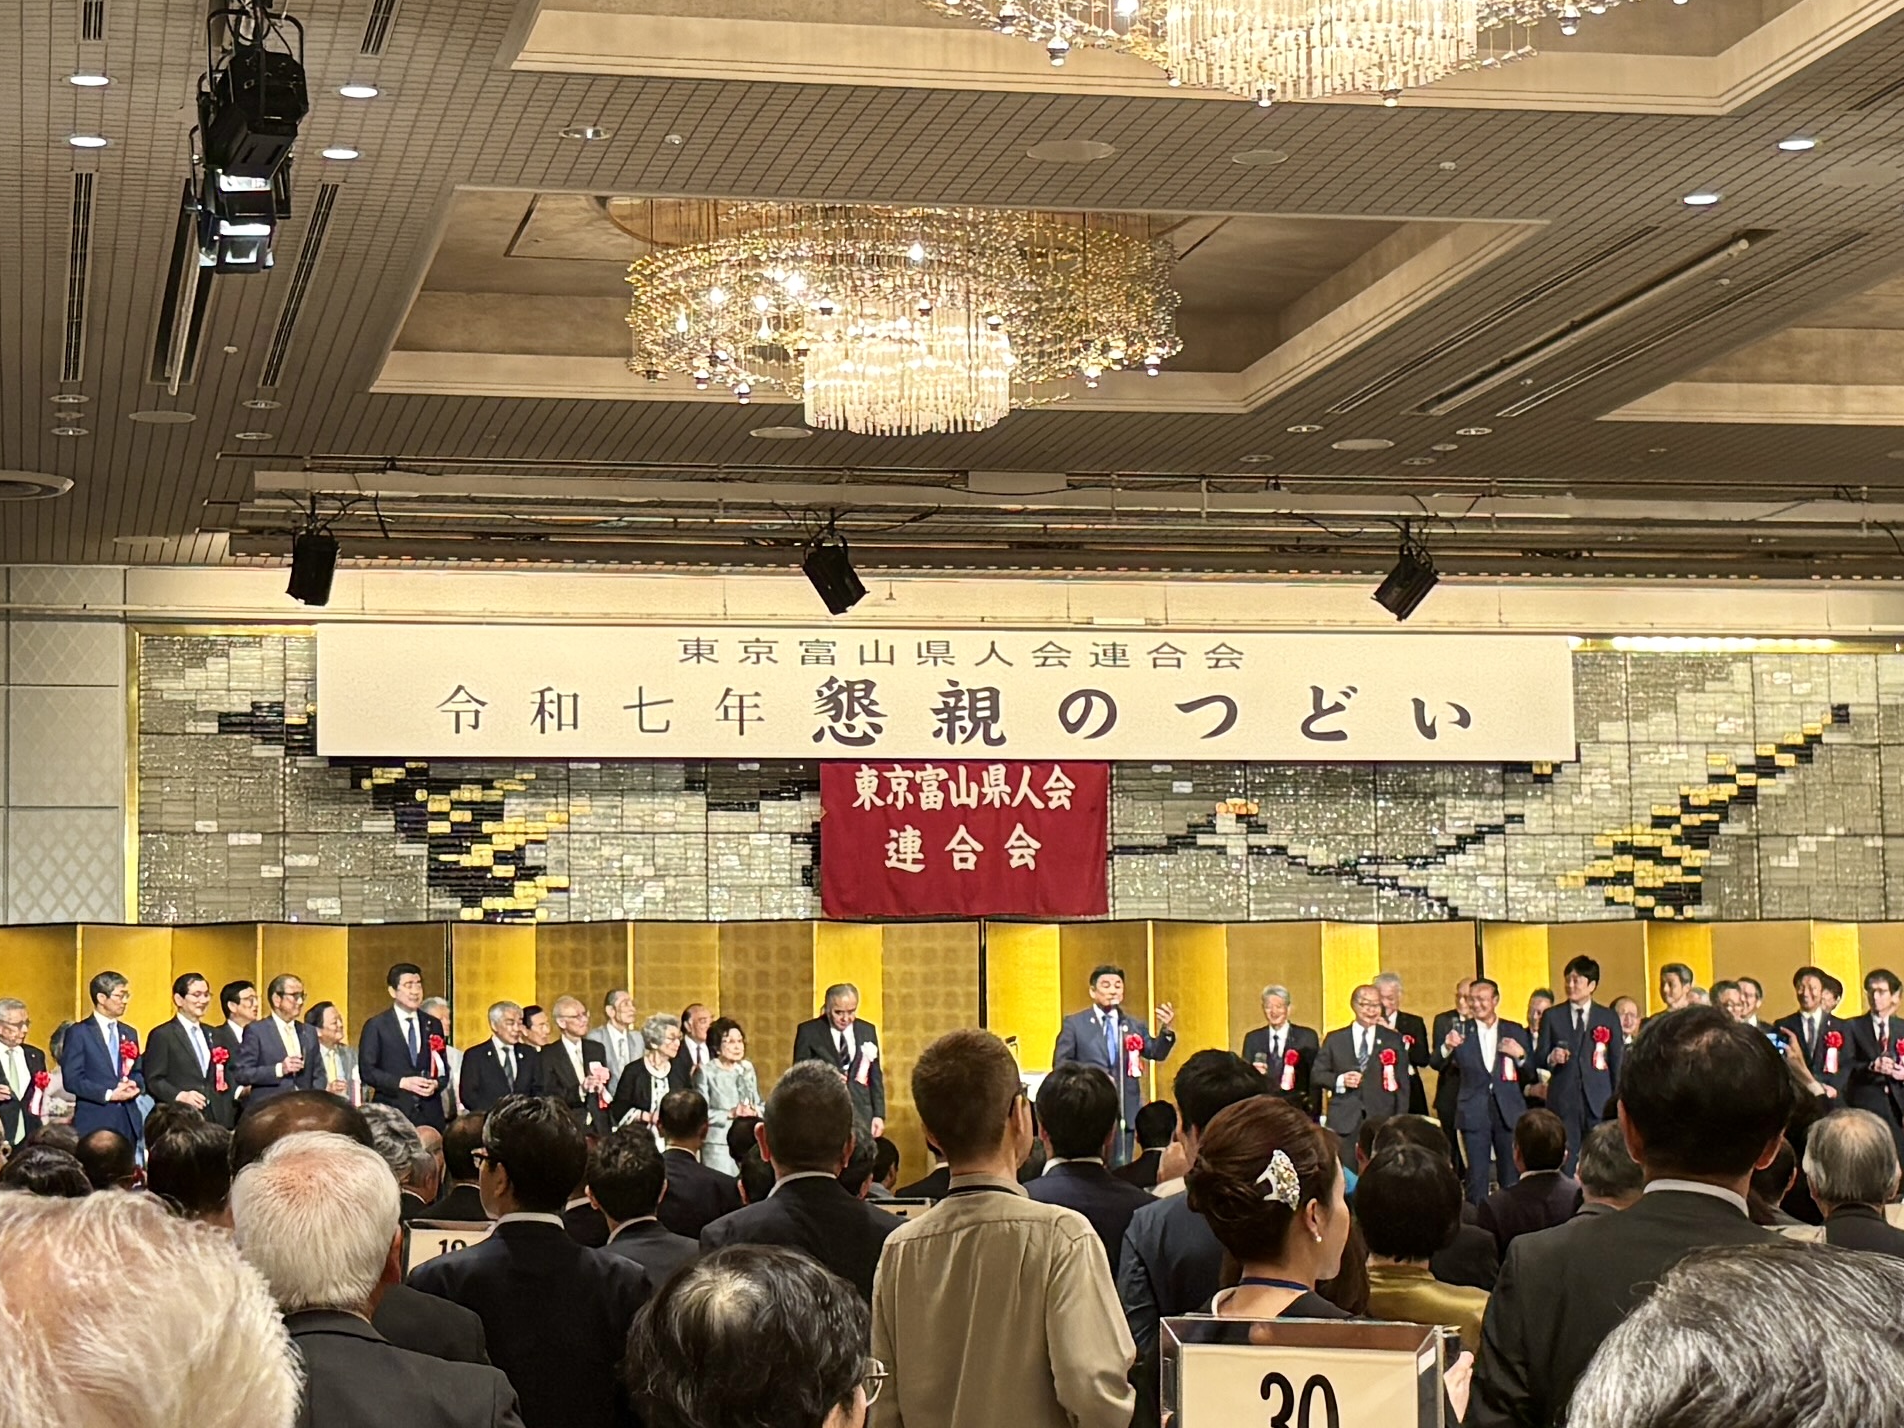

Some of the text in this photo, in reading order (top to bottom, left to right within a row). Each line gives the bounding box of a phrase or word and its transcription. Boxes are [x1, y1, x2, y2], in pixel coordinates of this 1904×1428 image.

[679, 634, 1248, 670] 東京富山県人会連合会
[437, 674, 1473, 747] 令和七年 懇親のつどい
[851, 763, 1074, 812] 東京富山県人会
[884, 821, 1043, 873] 連合会
